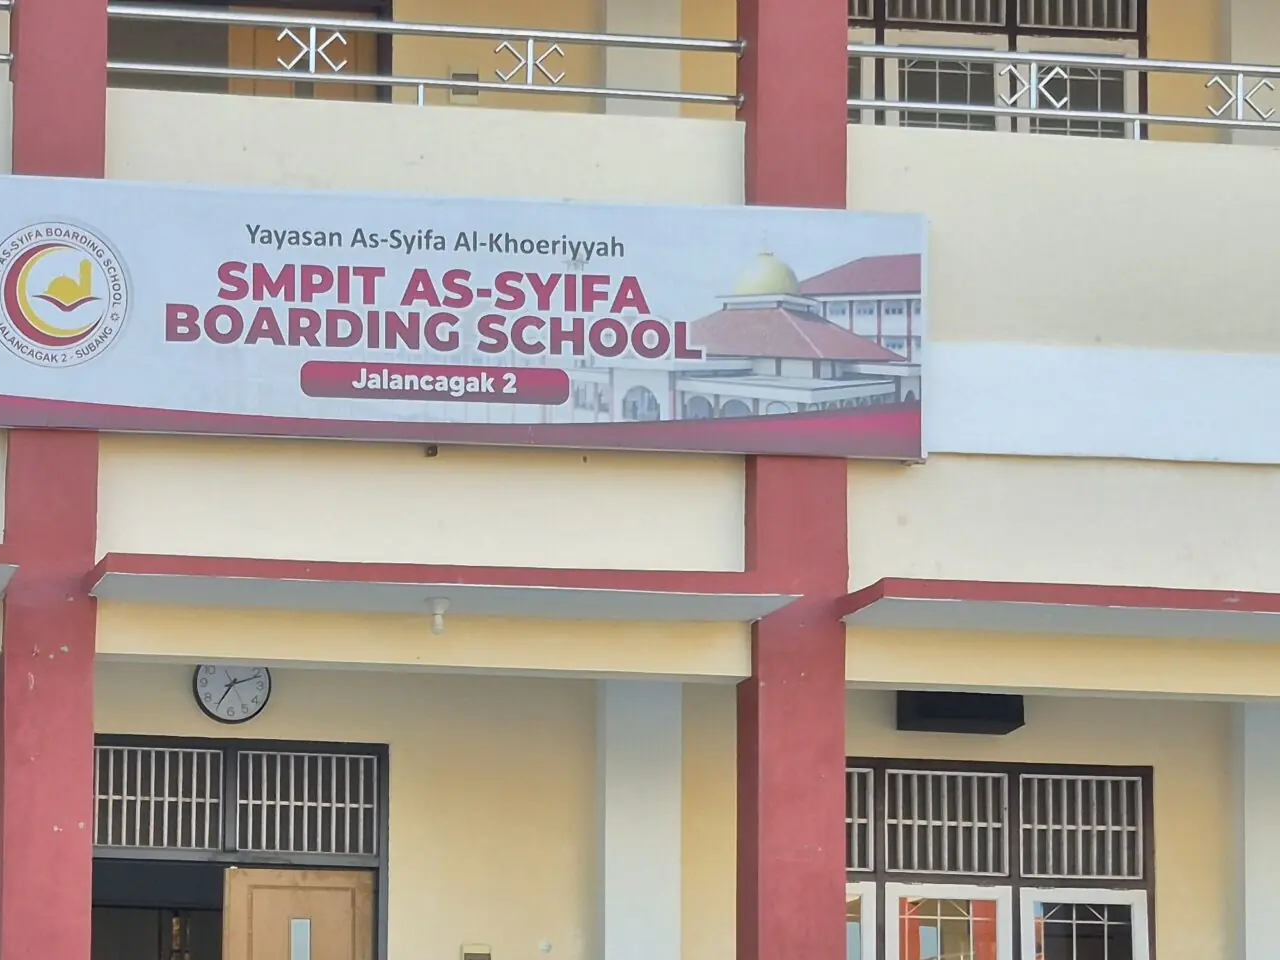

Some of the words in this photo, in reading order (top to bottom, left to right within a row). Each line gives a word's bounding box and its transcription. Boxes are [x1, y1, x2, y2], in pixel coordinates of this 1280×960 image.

[246, 224, 342, 250] Yayasan
[351, 228, 446, 254] As-Syifa
[454, 231, 625, 261] Al-Khoeriyyah
[45, 227, 105, 259] BOARDING
[102, 258, 122, 308] SCHOOL
[217, 261, 386, 305] SMPIT
[400, 268, 651, 315] AS-SYIFA
[165, 303, 460, 352] BOARDING
[477, 313, 702, 359] SCHOOL
[61, 353, 68, 363] 2
[75, 326, 113, 359] SUBANG
[351, 368, 495, 397] Jalancagak
[502, 372, 517, 394] 2
[200, 678, 208, 687] 9
[256, 681, 264, 691] 3
[204, 692, 212, 702] 8
[251, 695, 260, 705] 4
[227, 706, 235, 717] 6
[241, 704, 249, 714] 5
